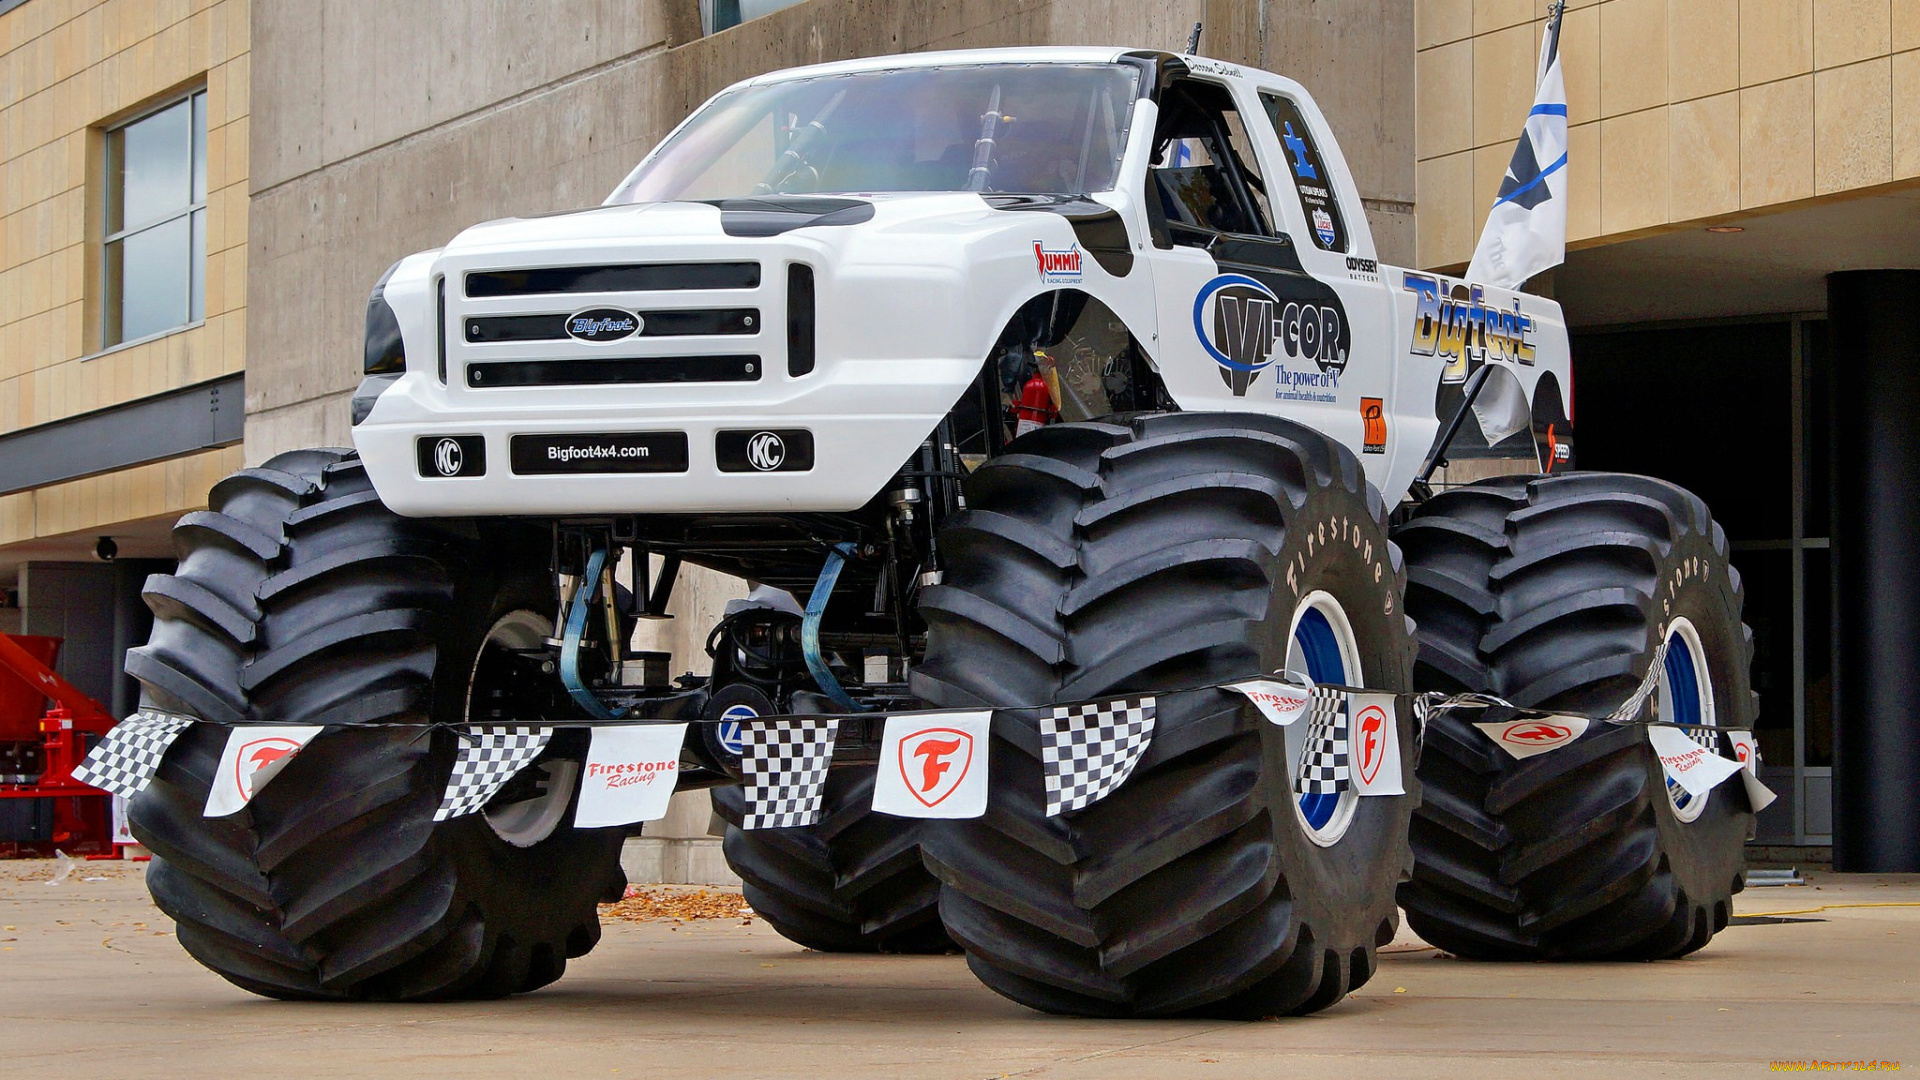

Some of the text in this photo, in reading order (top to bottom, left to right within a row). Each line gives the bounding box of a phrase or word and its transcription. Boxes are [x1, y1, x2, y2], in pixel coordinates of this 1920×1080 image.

[1346, 256, 1378, 274] ODYSSEY
[1350, 273, 1379, 283] BATTERY
[572, 318, 633, 336] Bigfoot
[1403, 271, 1537, 384] Bigfoot
[1275, 364, 1292, 385] The
[1293, 371, 1320, 391] power
[1321, 366, 1331, 388] of
[1275, 387, 1283, 399] for
[1283, 389, 1298, 400] animal
[1299, 390, 1312, 401] health
[1317, 392, 1337, 403] nutrition
[440, 441, 459, 472] KC
[548, 445, 649, 461] Bigfoot4x4.com
[753, 435, 780, 468] KC
[1286, 515, 1382, 597] Firestone
[914, 737, 961, 792] F
[1660, 749, 1705, 767] Firestone
[1675, 756, 1703, 774] Racing
[588, 759, 676, 778] Firestone
[606, 770, 656, 790] Racing
